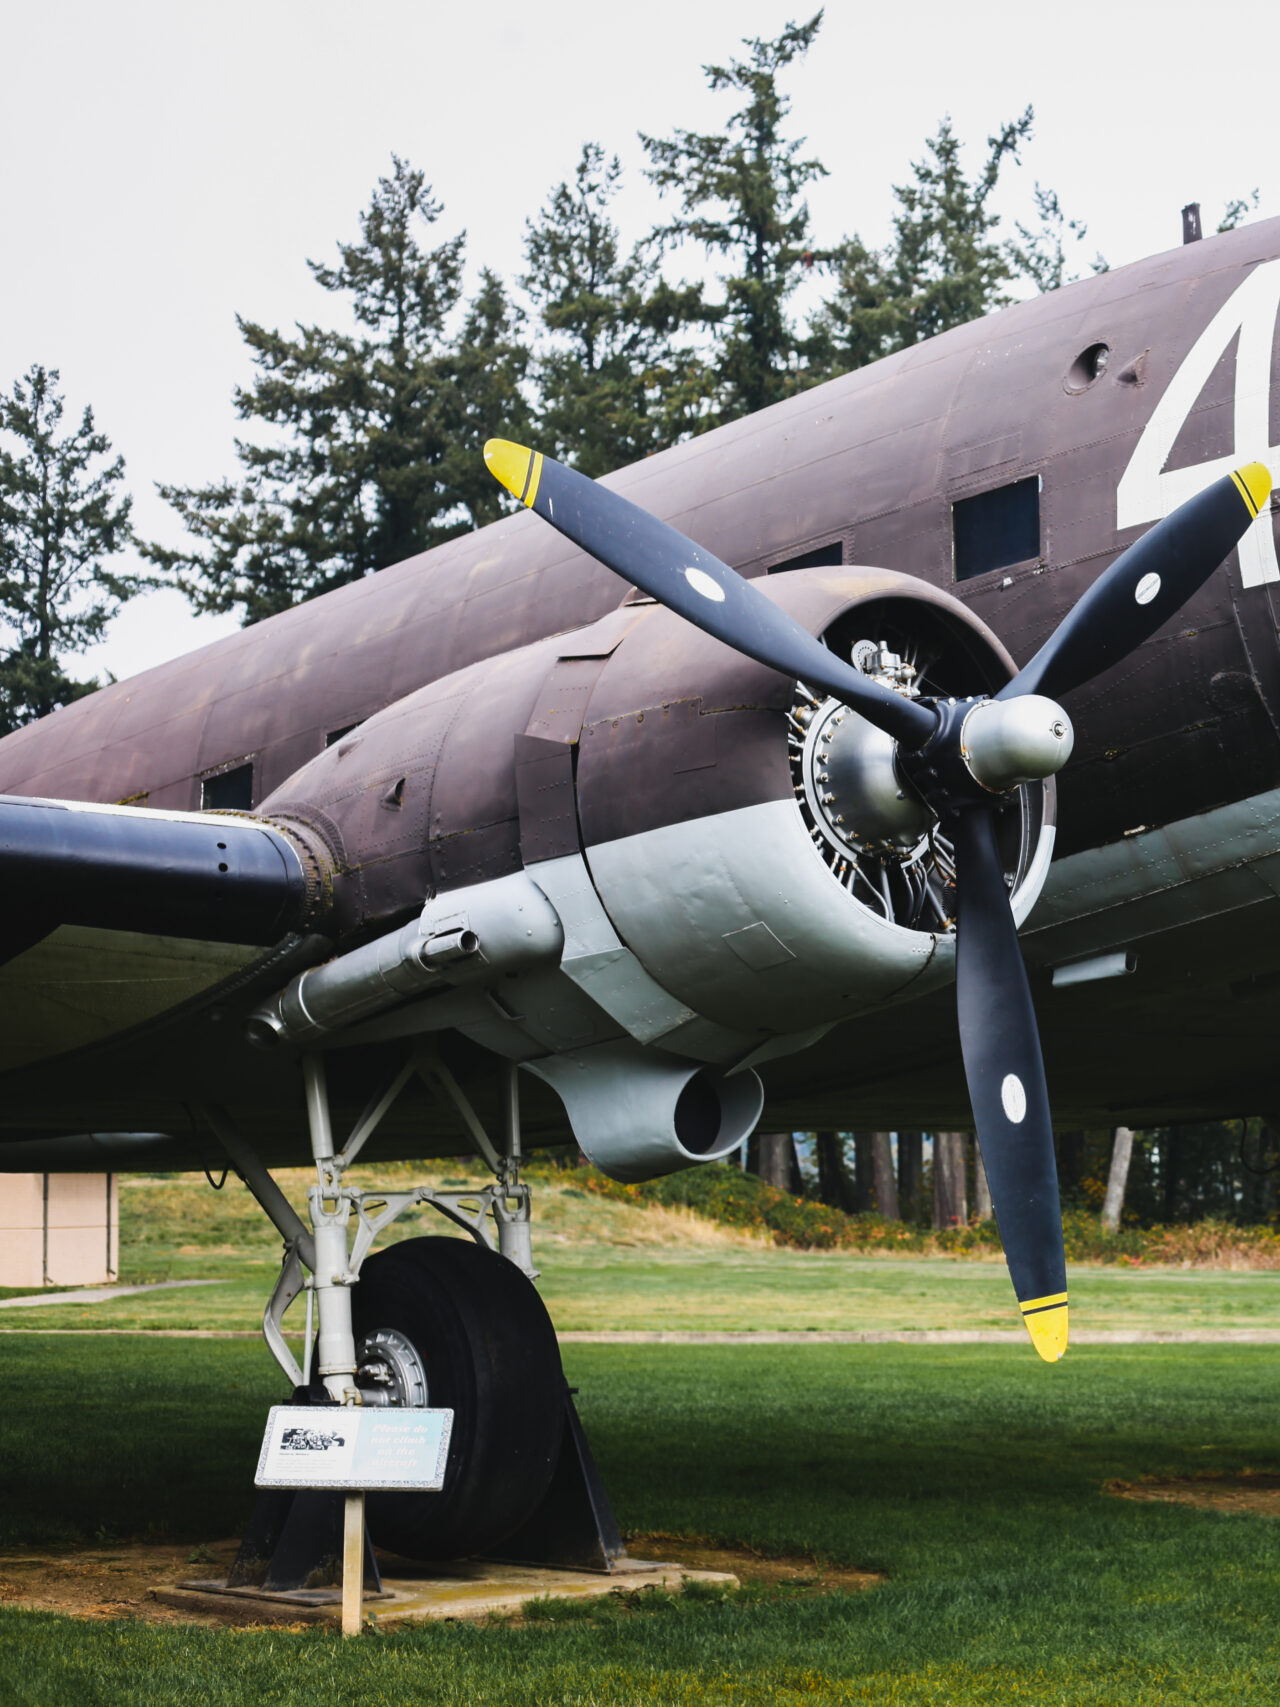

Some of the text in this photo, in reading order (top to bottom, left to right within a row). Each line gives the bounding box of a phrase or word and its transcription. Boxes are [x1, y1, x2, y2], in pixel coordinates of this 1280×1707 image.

[372, 1424, 428, 1433] Please do
[393, 1435, 425, 1444] climb
[395, 1447, 416, 1456] the
